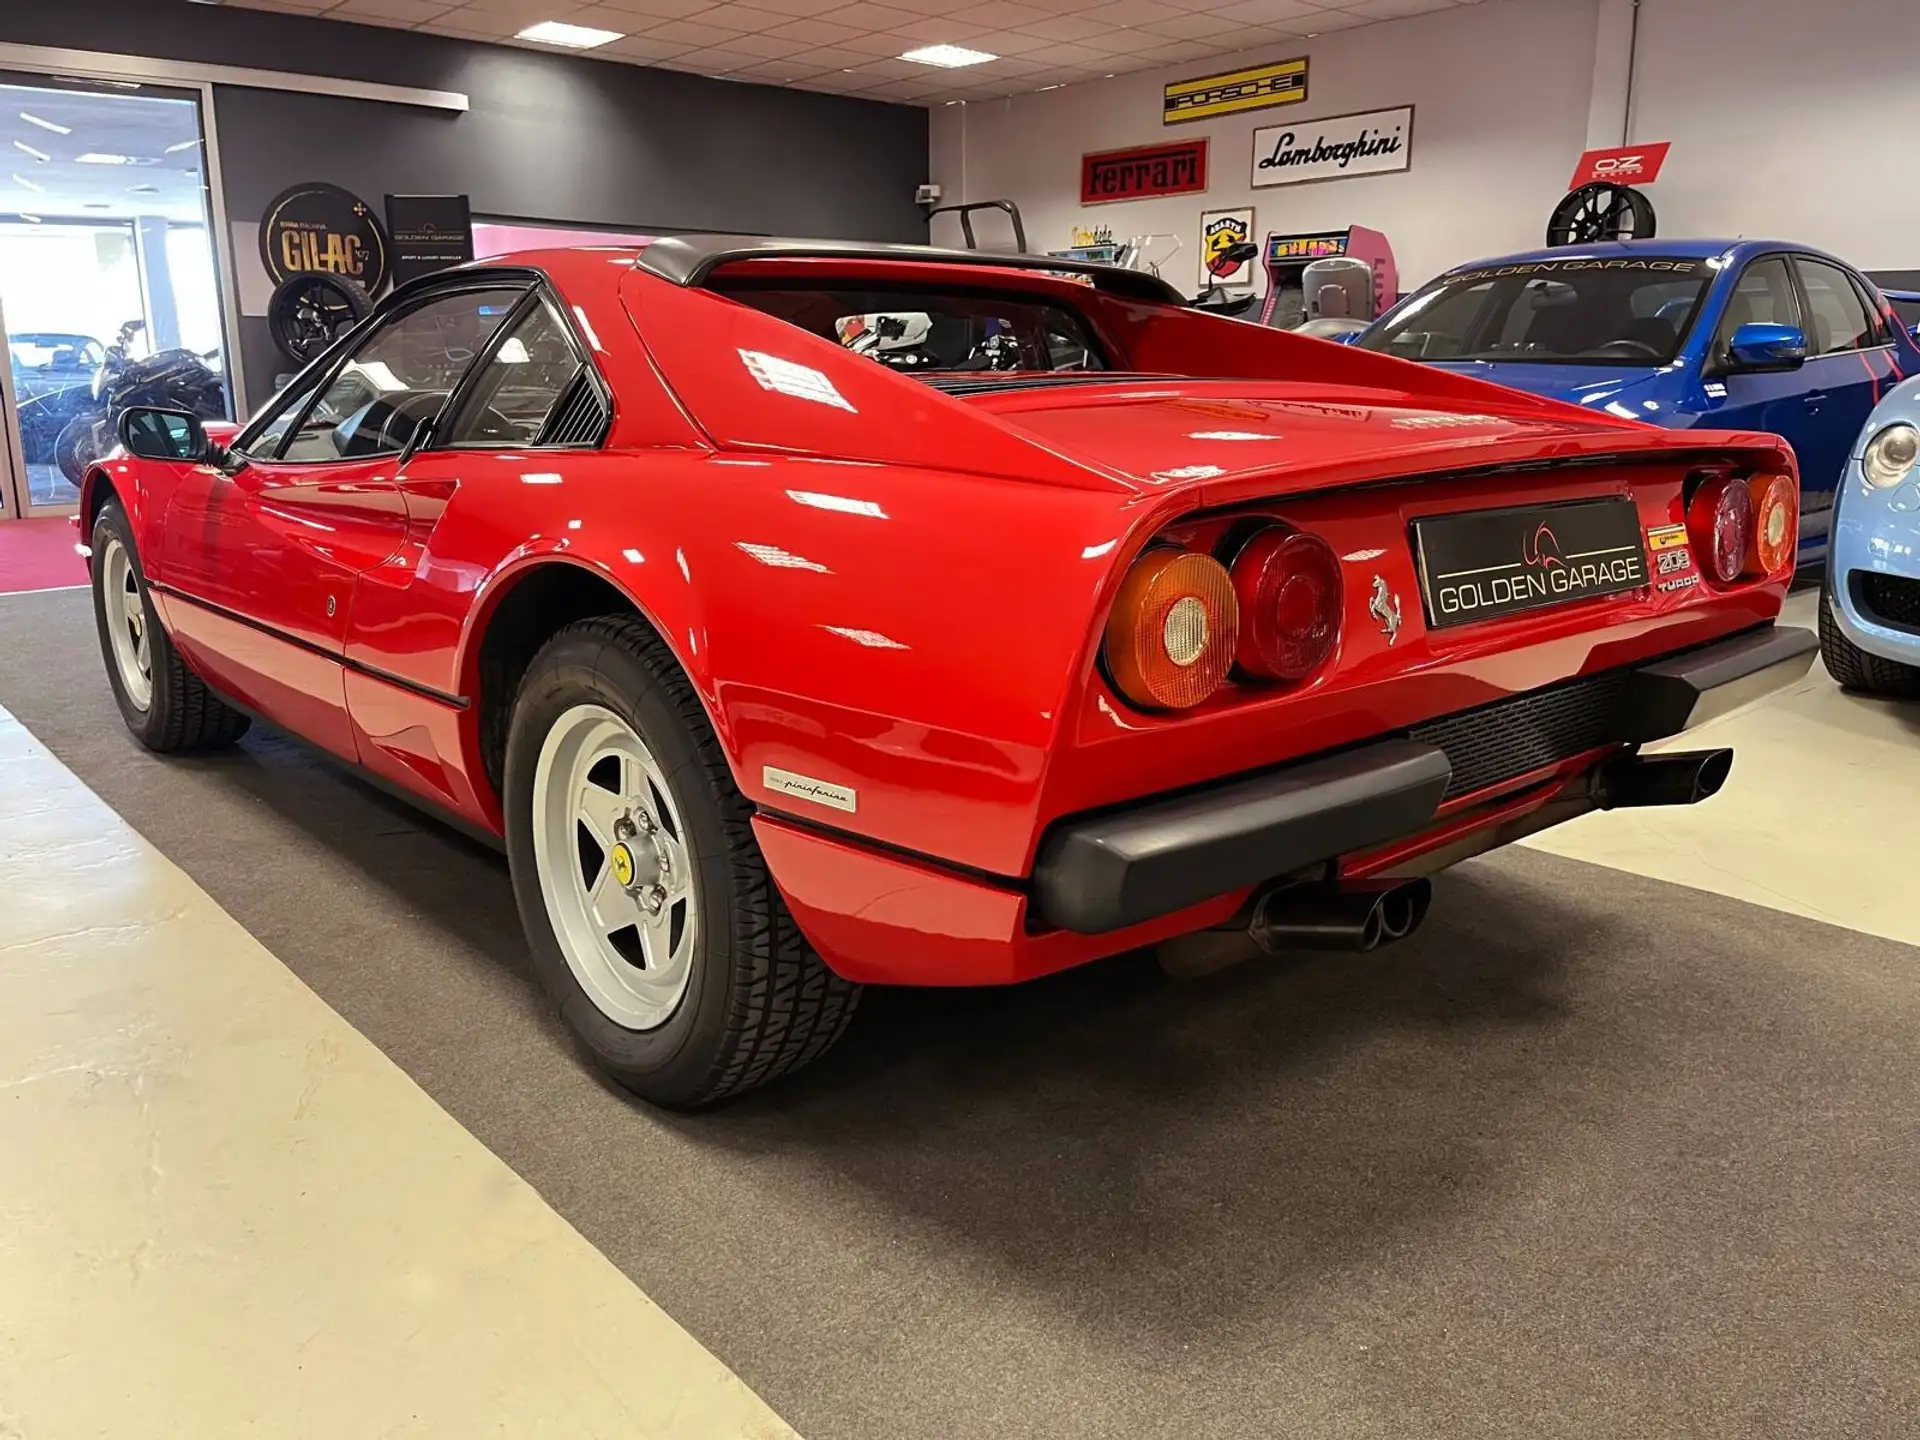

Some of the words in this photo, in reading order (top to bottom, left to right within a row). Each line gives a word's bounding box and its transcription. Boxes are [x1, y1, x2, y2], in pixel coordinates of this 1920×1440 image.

[1177, 76, 1292, 108] PORSCHE
[1258, 125, 1402, 169] Lamborghini
[1088, 149, 1197, 195] Ferrari
[1209, 219, 1242, 235] ABARTH
[281, 229, 364, 276] GILAC
[1443, 262, 1559, 286] GOLDEN
[1562, 260, 1697, 273] GARAGE
[1440, 572, 1547, 614] GOLDEN
[1550, 557, 1641, 593] GARAGE
[784, 780, 849, 803] pininfarina
